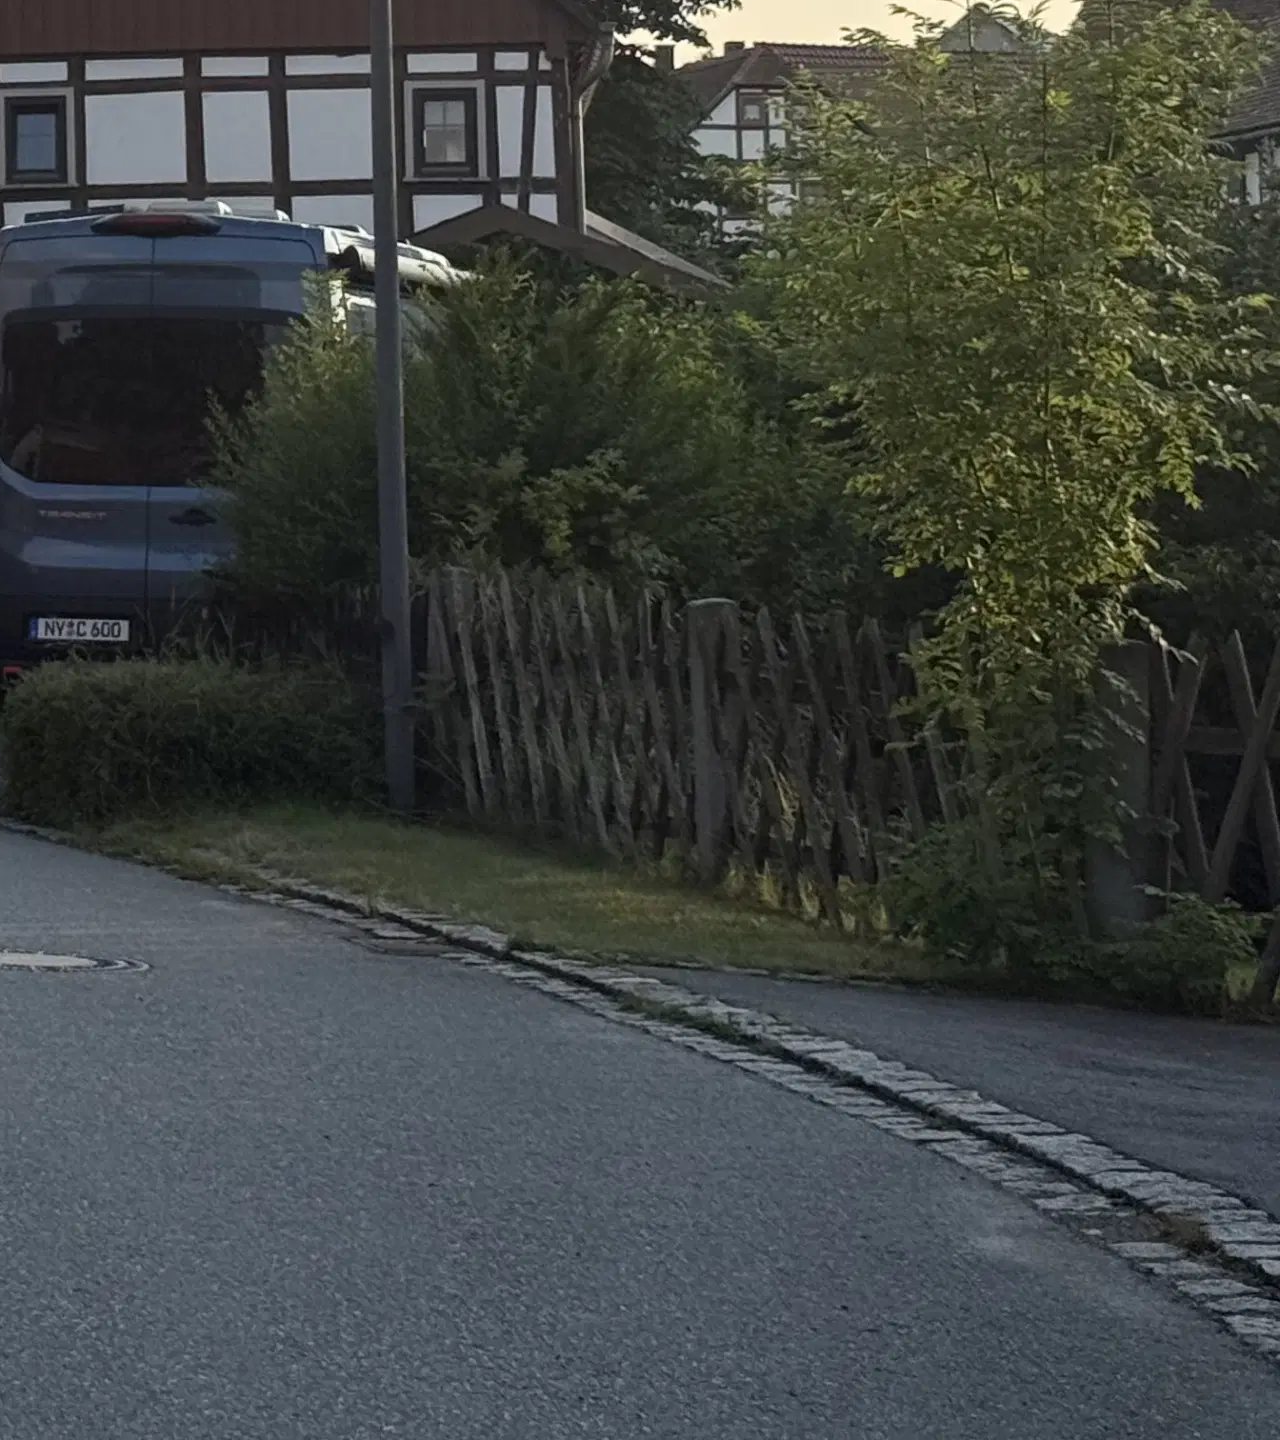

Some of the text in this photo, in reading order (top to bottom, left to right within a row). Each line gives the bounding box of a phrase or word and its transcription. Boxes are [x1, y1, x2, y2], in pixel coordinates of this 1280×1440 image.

[44, 621, 121, 638] NY C 600
